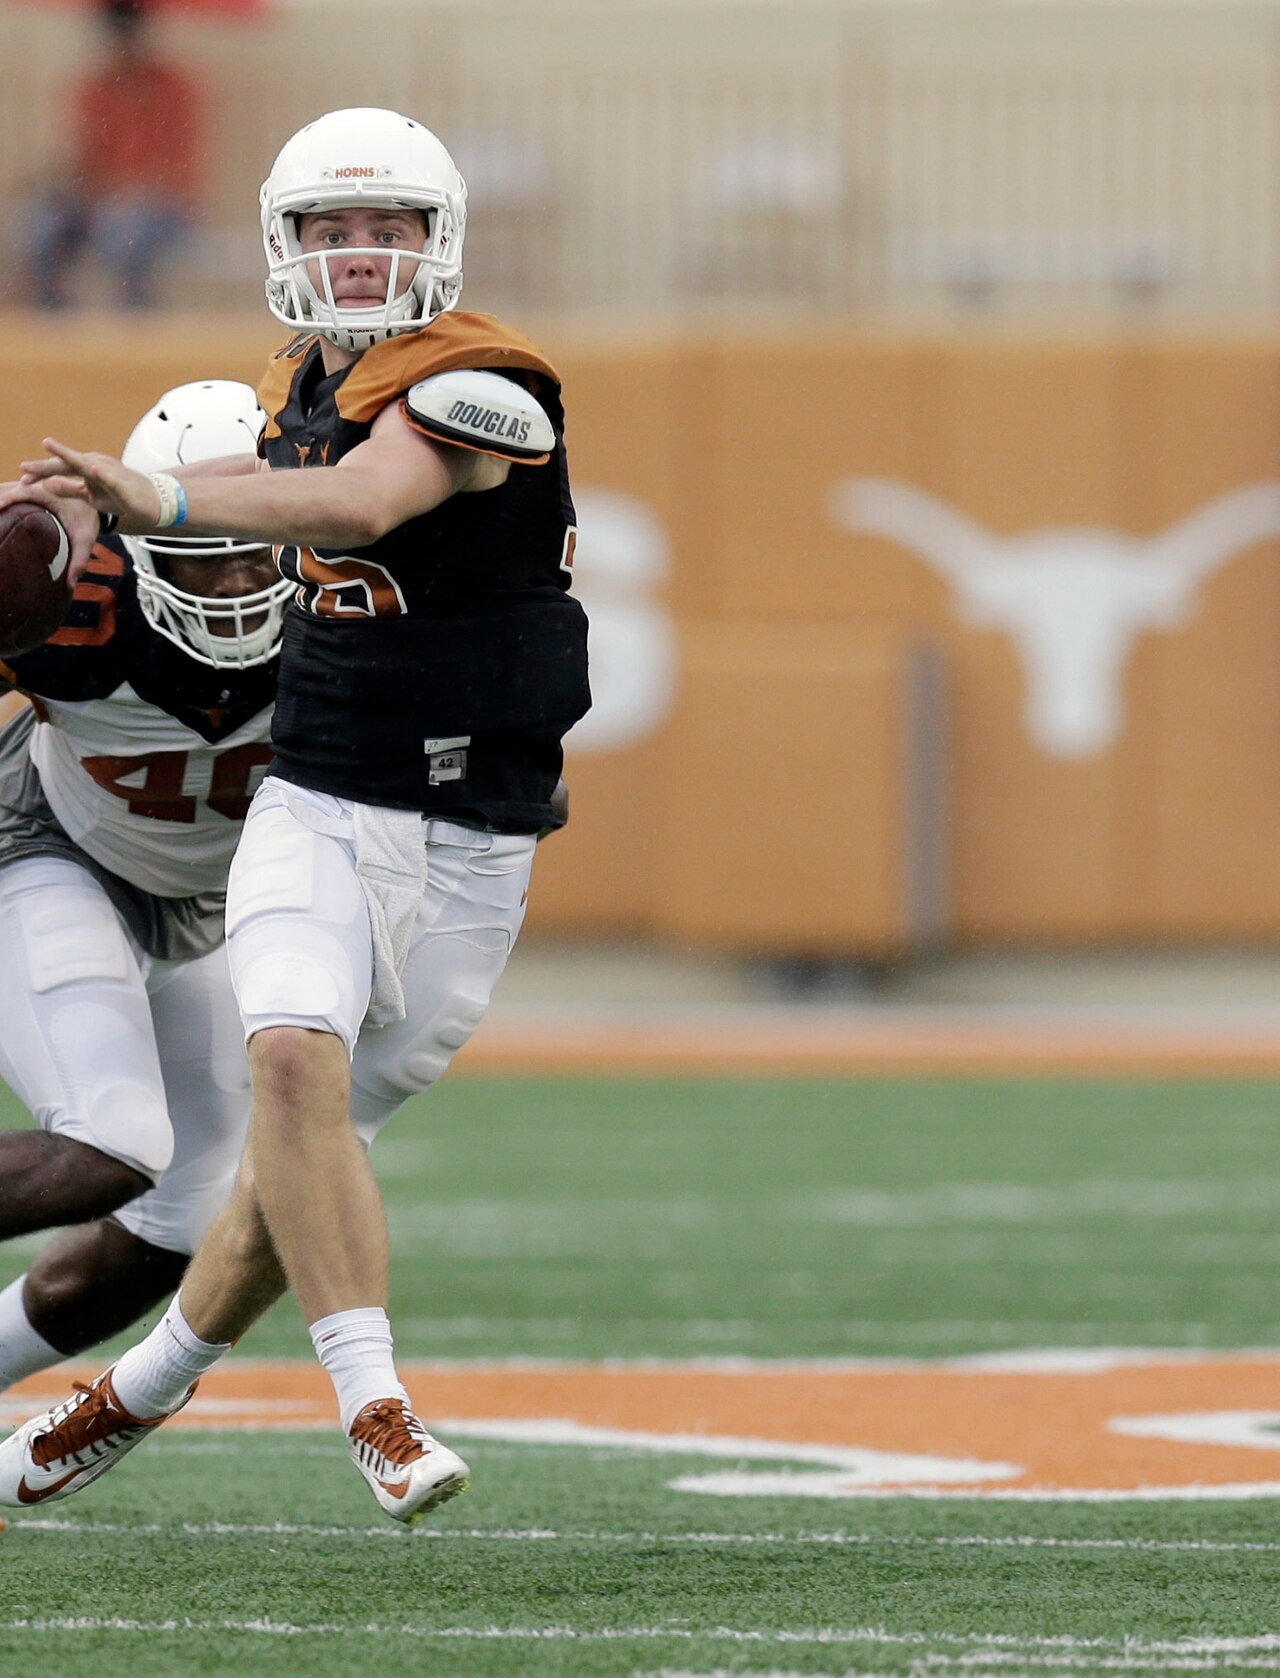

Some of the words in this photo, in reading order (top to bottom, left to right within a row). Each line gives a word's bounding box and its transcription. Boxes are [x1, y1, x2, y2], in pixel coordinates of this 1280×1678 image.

[335, 167, 375, 178] HORNS
[446, 400, 532, 444] DOUGLAS
[438, 757, 454, 769] 42
